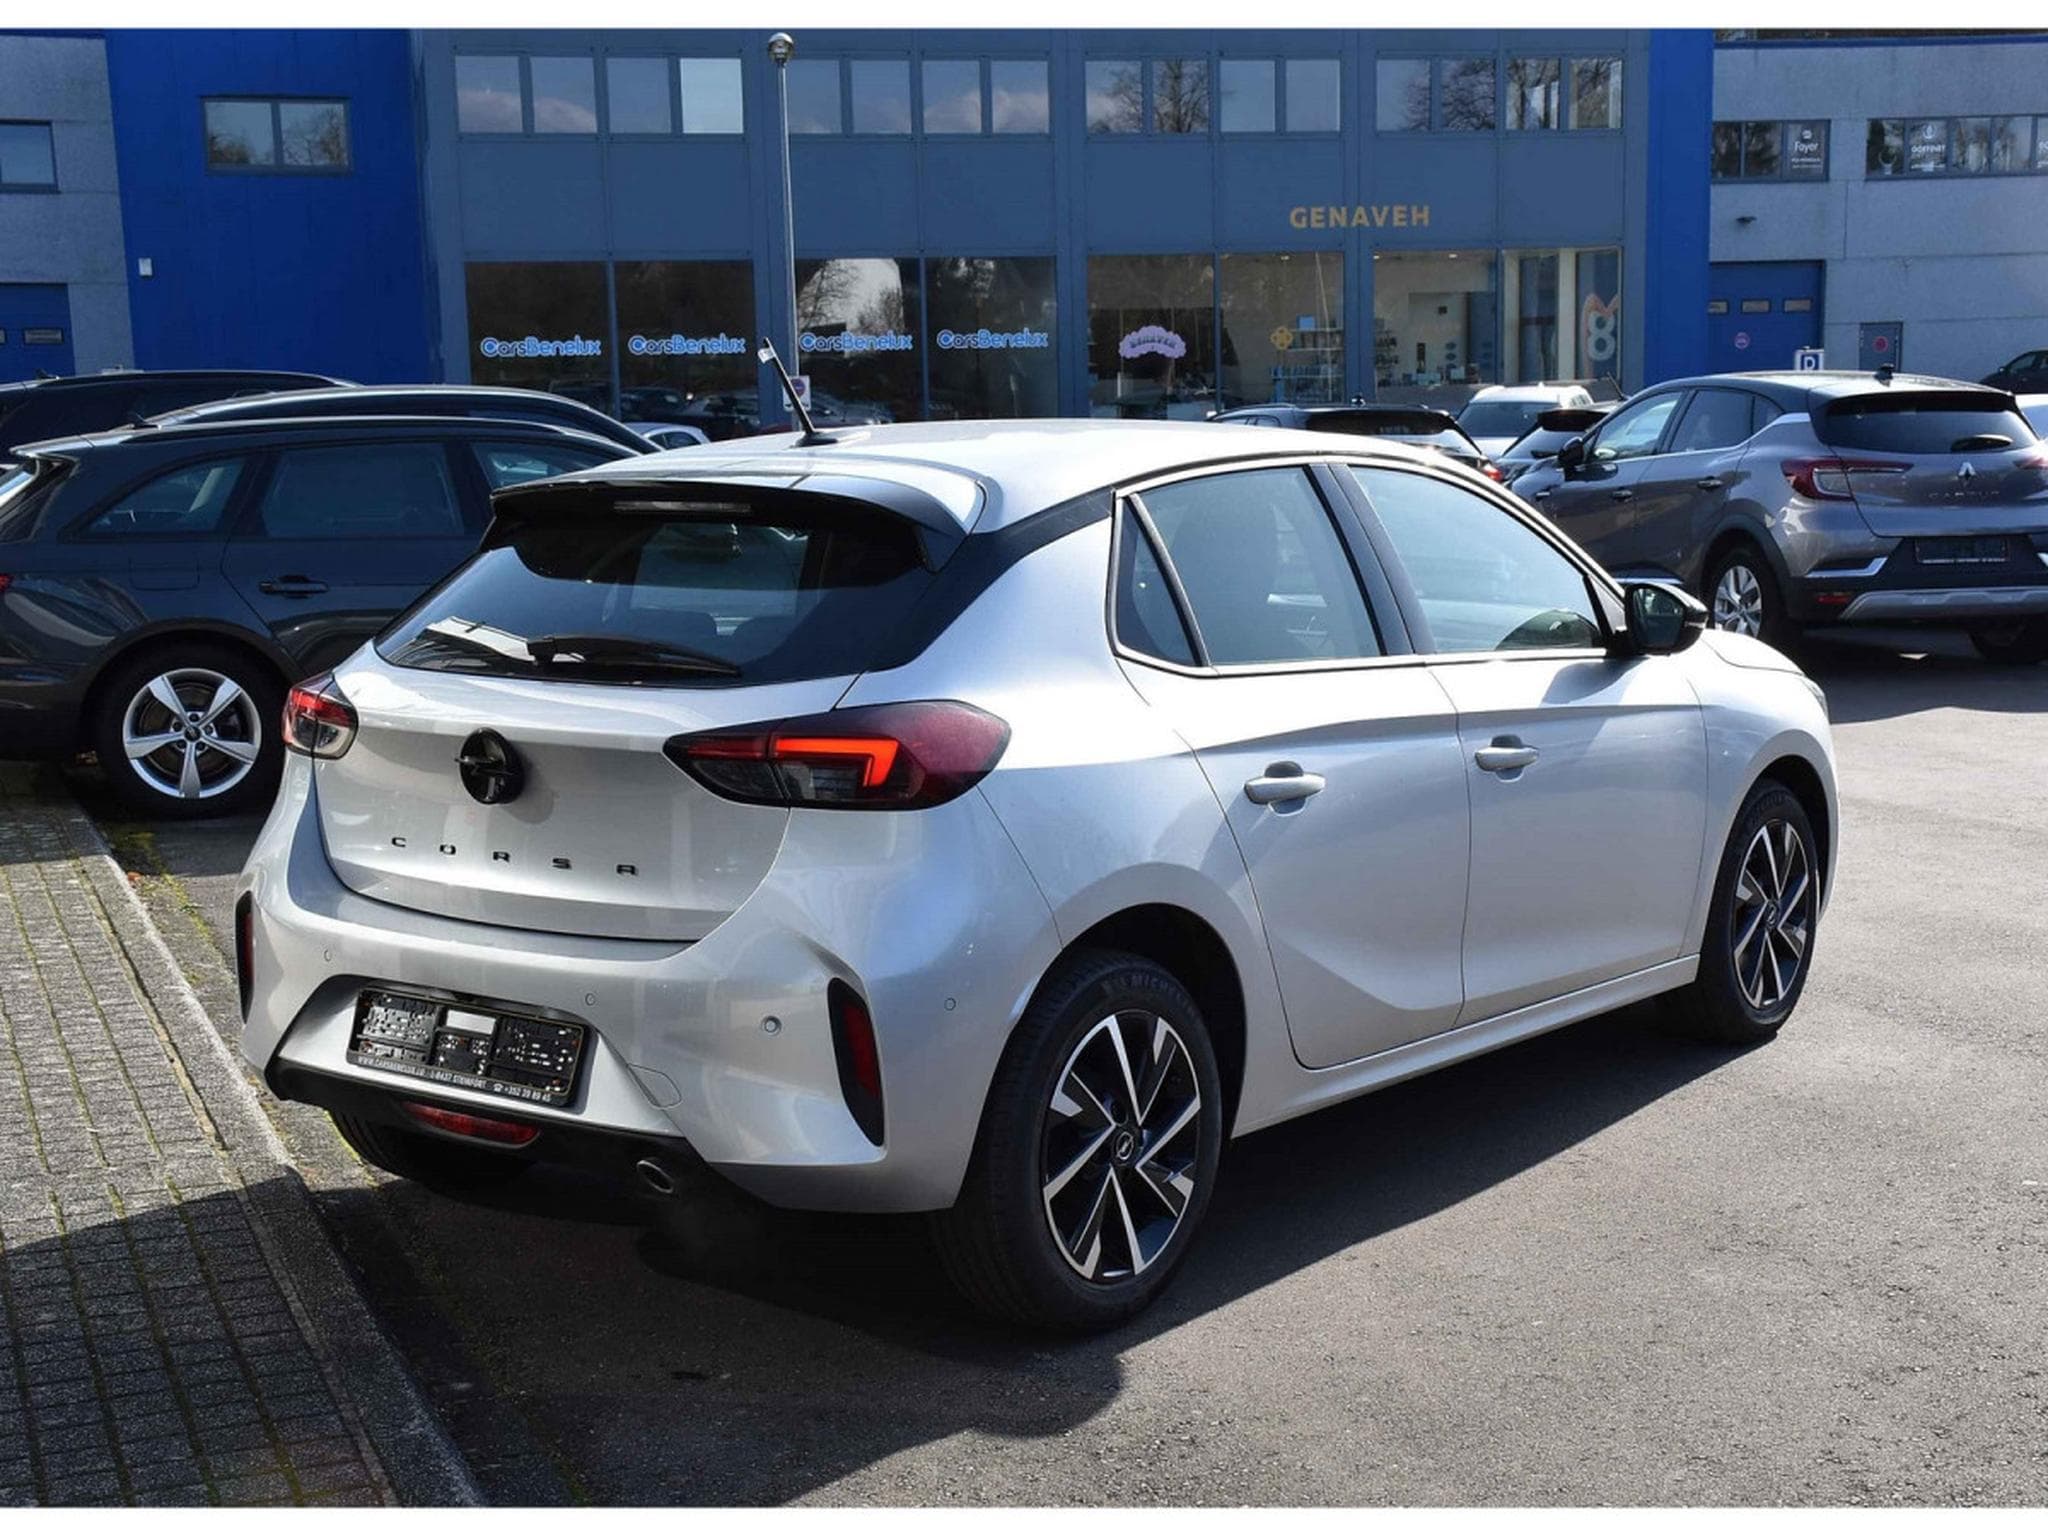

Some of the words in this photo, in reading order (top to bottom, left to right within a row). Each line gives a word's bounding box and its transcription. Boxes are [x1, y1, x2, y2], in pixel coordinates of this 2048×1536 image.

[1289, 205, 1431, 229] GENAVEH
[480, 334, 602, 357] CarsBenelux
[628, 332, 746, 355] CarsBenelux
[799, 329, 913, 352] CarsBenelux
[936, 327, 1049, 349] CarsBenelux
[391, 836, 638, 876] CORSA
